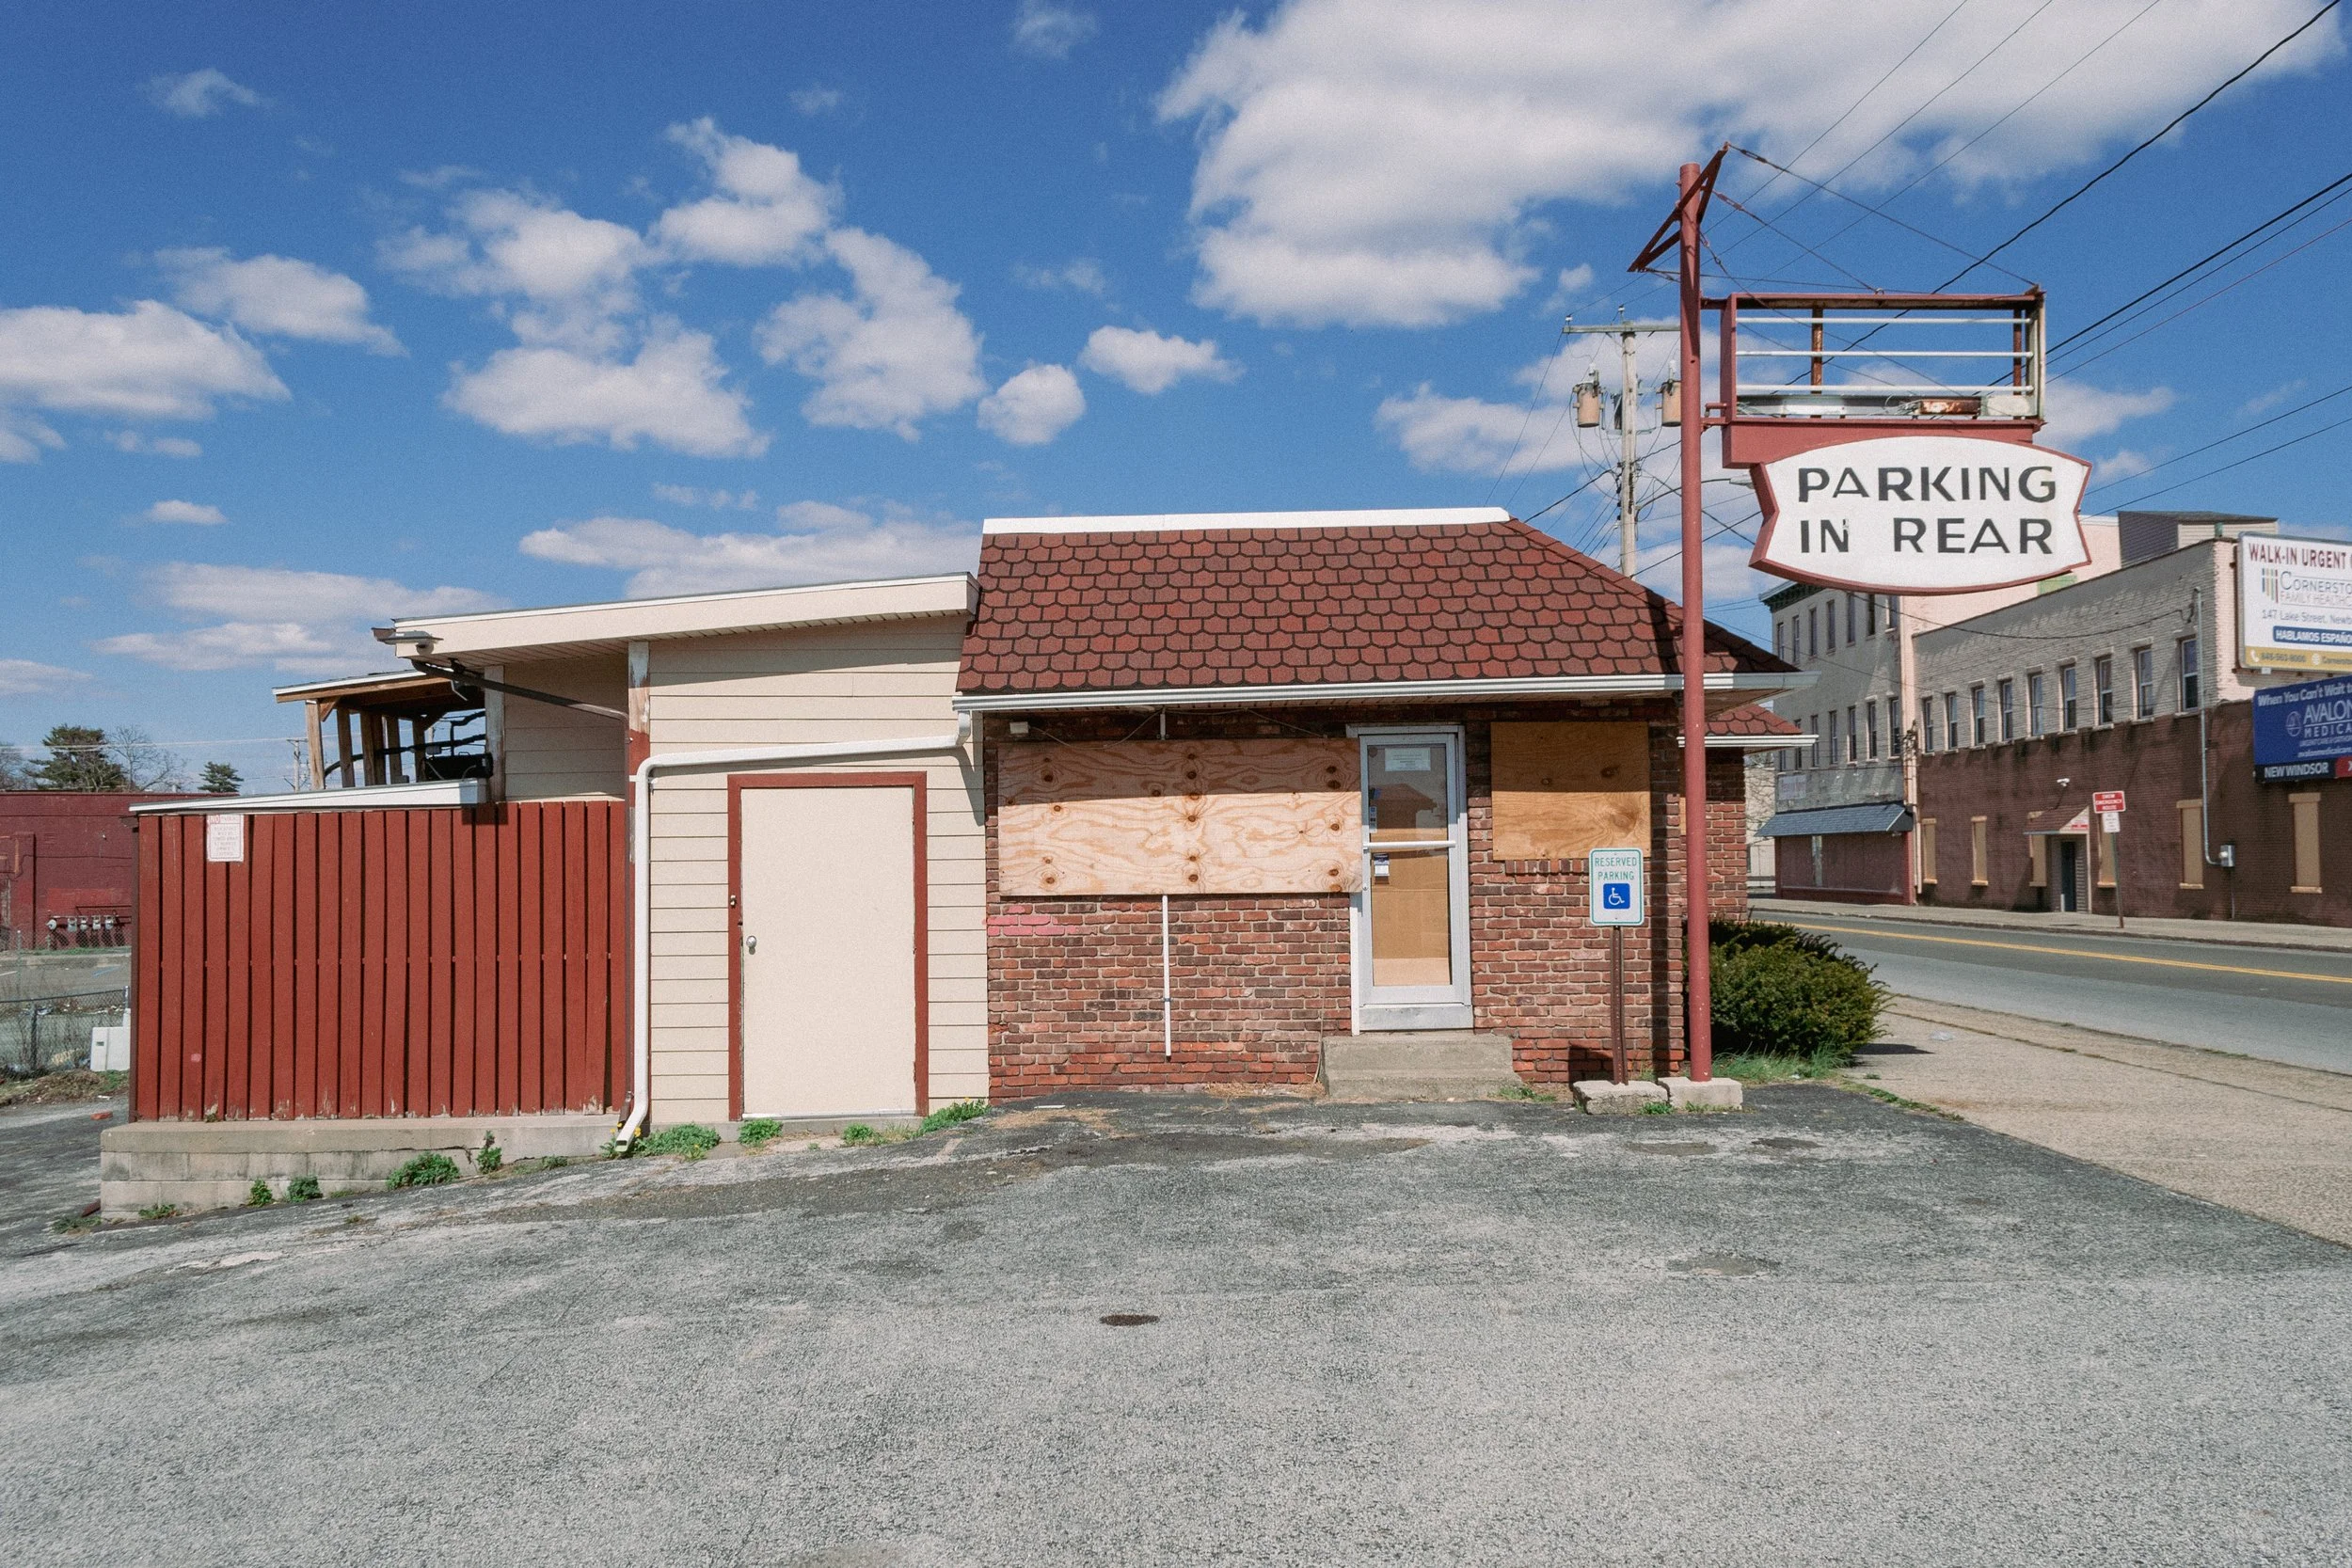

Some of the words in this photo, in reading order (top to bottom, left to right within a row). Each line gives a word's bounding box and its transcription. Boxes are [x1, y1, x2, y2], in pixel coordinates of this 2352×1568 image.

[1798, 466, 2057, 503] PARKING
[1800, 518, 1850, 553] IN
[1893, 517, 2053, 554] REAR
[2249, 543, 2297, 564] WALK-IN
[2301, 548, 2346, 569] URGENT
[2280, 590, 2311, 604] FAMILY
[2262, 610, 2277, 619] 147
[2280, 610, 2299, 622] Lake
[2275, 628, 2320, 642] HABLAMOS
[2258, 694, 2282, 707] When
[2283, 690, 2299, 704] You
[2300, 685, 2324, 700] Can't
[2324, 682, 2345, 696] Wait
[2265, 765, 2285, 779] NEW
[2285, 762, 2329, 777] WINDSOR
[210, 815, 220, 824] NO
[1595, 857, 1637, 866] RESERVED
[1597, 871, 1634, 880] PARKING
